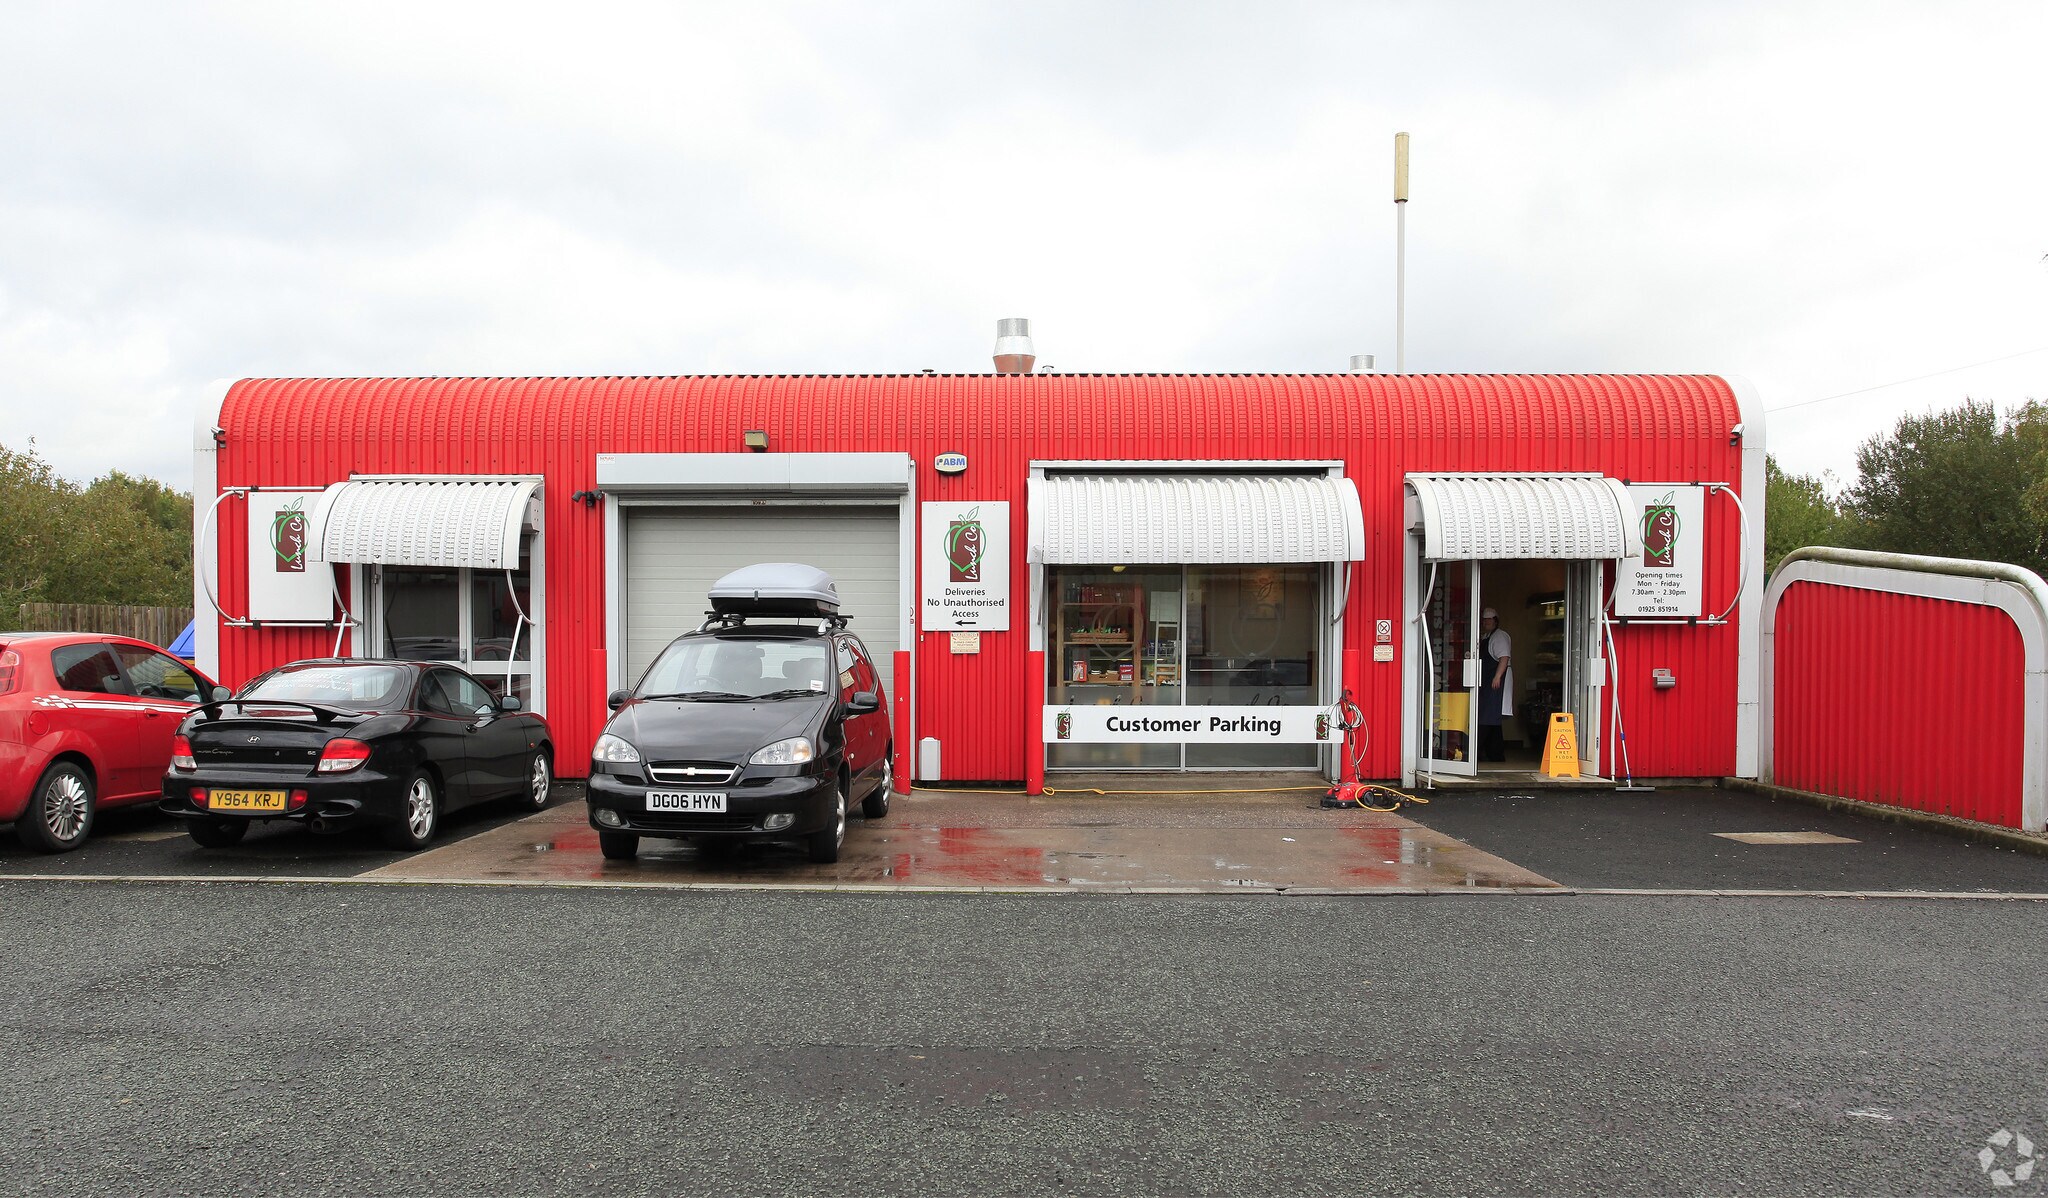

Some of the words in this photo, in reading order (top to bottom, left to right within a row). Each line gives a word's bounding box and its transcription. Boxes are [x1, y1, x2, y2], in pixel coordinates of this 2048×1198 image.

[943, 457, 966, 466] ABM
[1658, 529, 1672, 565] Lunch
[289, 534, 303, 570] Lunch
[964, 544, 978, 580] Lunch
[1635, 571, 1663, 580] Opening
[1665, 571, 1683, 579] times
[1660, 580, 1681, 588] Friday
[945, 588, 986, 596] Deliveries
[1663, 588, 1687, 597] 2.30pm
[927, 598, 940, 607] No
[943, 598, 1005, 607] Unauthorised
[951, 610, 980, 618] Access
[1106, 716, 1201, 732] Customer
[1209, 716, 1282, 735] Parking
[216, 792, 250, 807] Y964
[254, 793, 281, 807] KRJ
[652, 793, 689, 809] DG06
[693, 794, 721, 809] HYN
